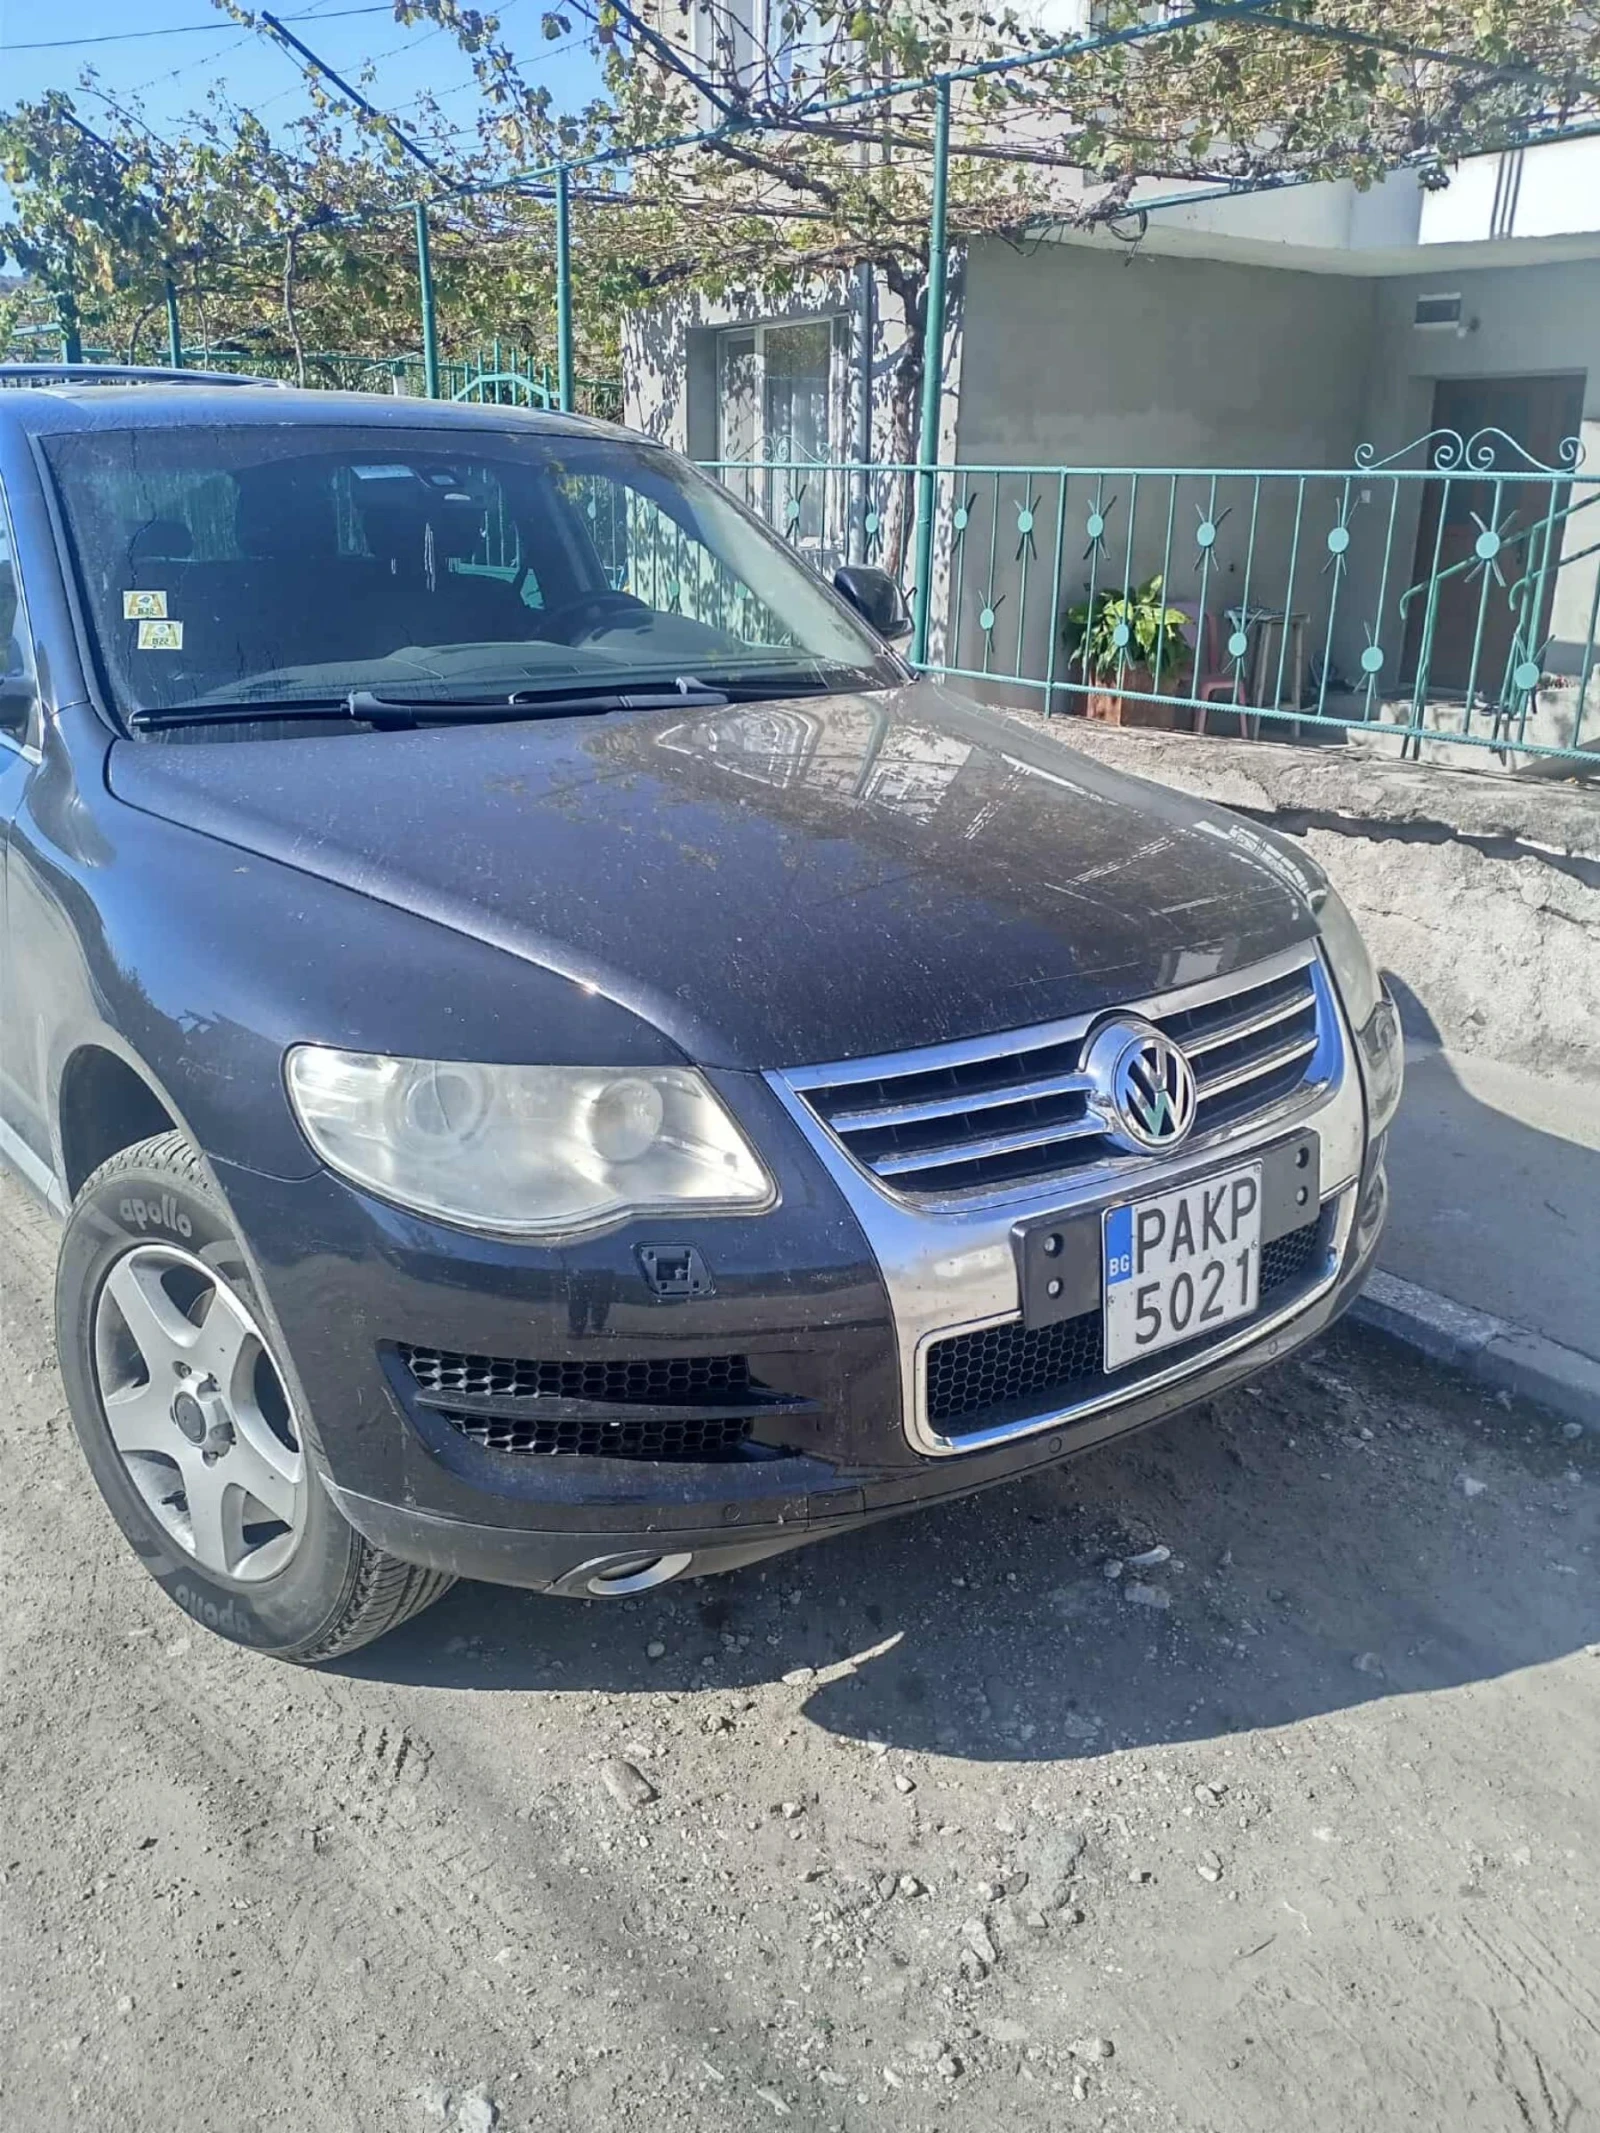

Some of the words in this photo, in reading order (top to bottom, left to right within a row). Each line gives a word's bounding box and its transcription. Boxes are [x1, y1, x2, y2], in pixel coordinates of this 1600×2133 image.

[120, 1193, 192, 1238] apollo
[1136, 1177, 1257, 1274] PAKP
[1109, 1253, 1130, 1277] BG
[1135, 1247, 1249, 1345] 5021
[175, 1584, 251, 1641] apollo
